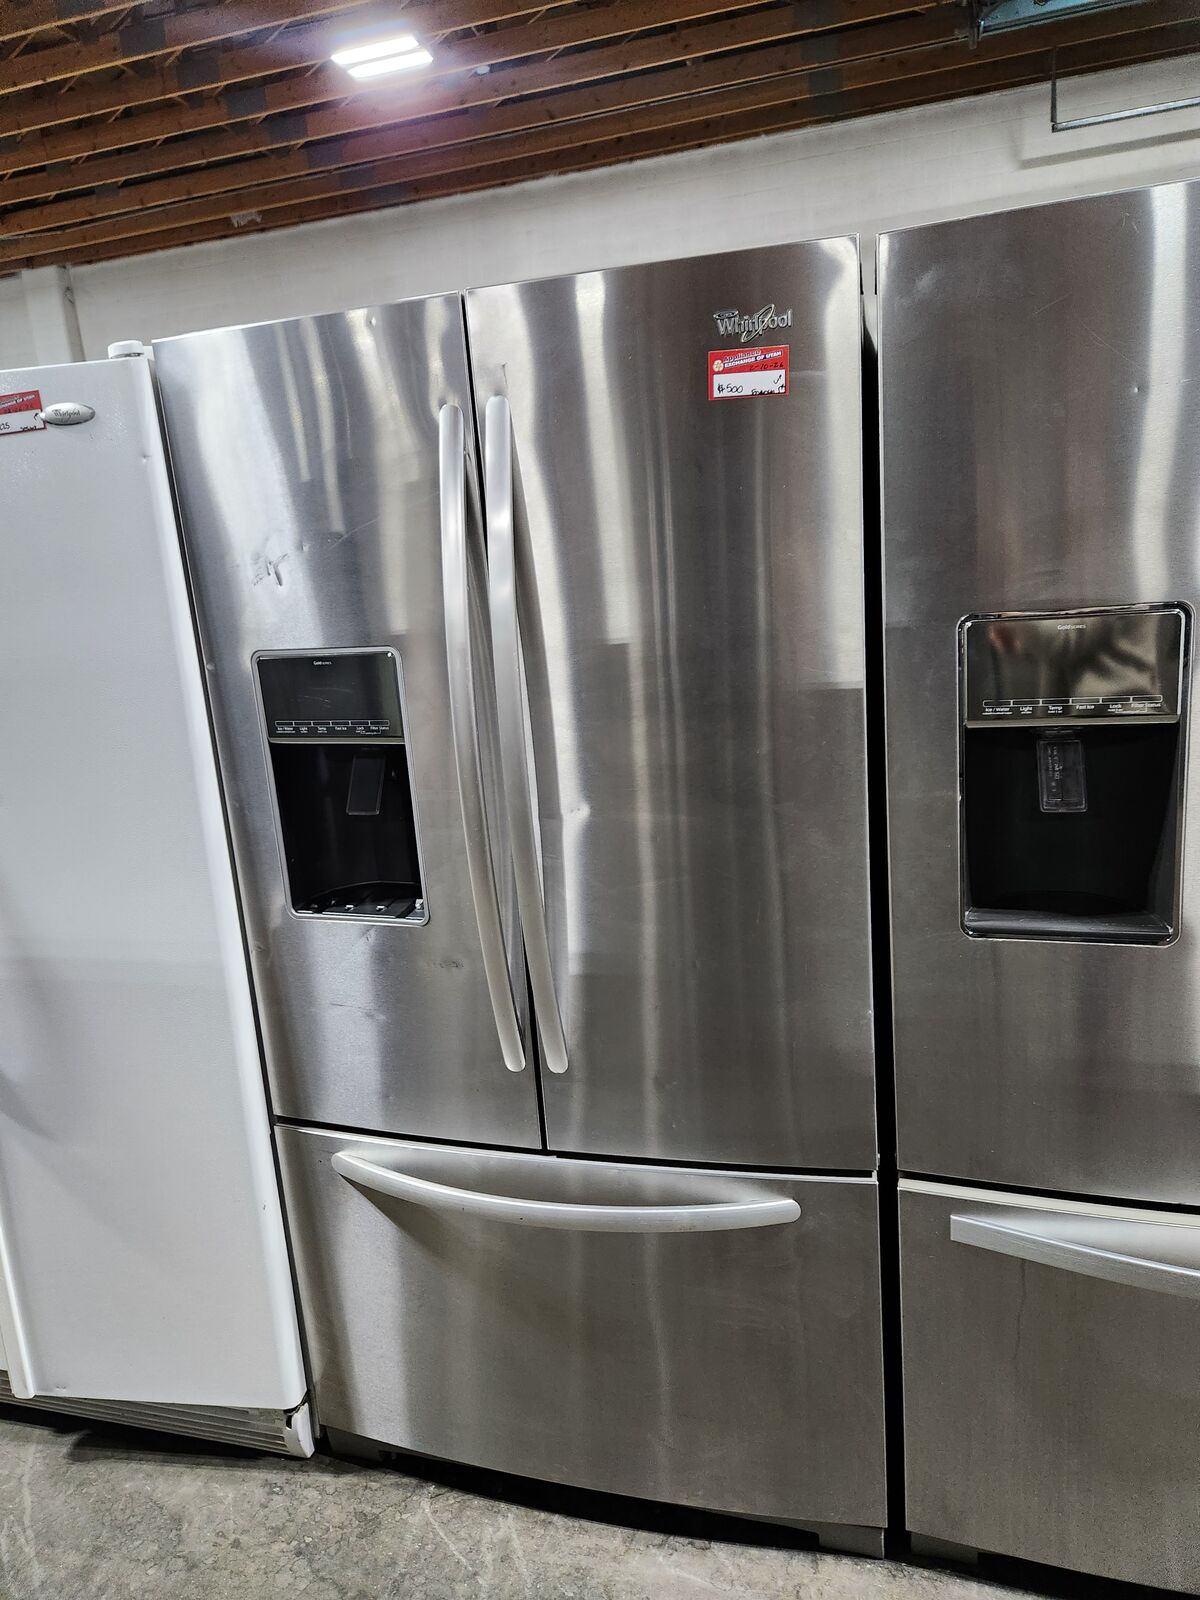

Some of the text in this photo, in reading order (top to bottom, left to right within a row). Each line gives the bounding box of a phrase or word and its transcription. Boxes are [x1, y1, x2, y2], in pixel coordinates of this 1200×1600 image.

[715, 306, 792, 339] Whirlpool
[724, 357, 756, 369] EXCHANGE
[765, 351, 782, 359] UTAH
[717, 383, 744, 395] $500
[52, 408, 81, 419] Whirlpool
